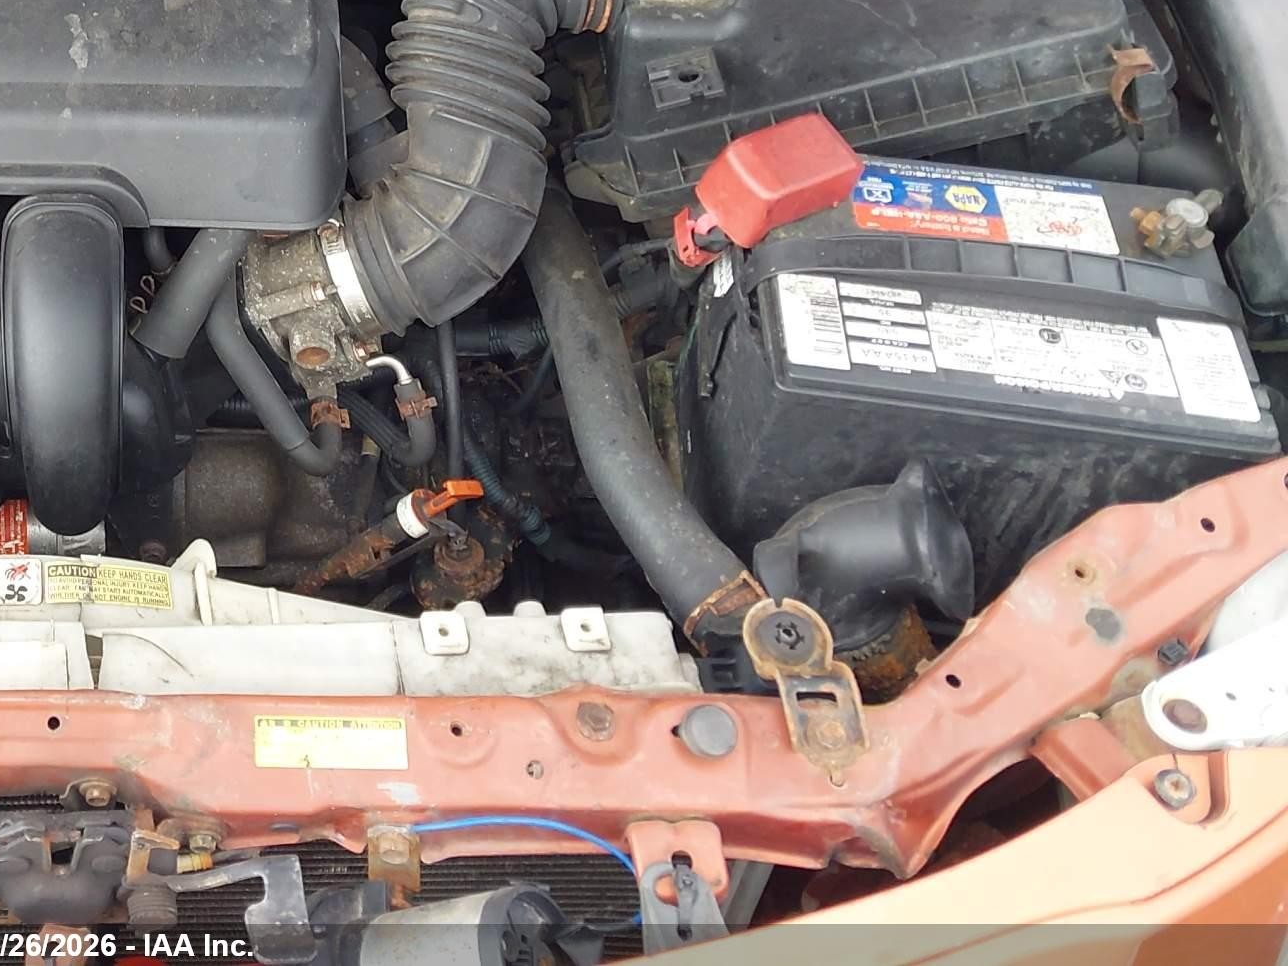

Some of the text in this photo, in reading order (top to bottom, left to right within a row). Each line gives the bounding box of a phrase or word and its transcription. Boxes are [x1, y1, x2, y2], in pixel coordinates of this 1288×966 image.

[952, 192, 981, 205] NAPA
[48, 565, 97, 578] CAUTION
[98, 570, 116, 578] KEEP
[119, 571, 142, 581] HANDS
